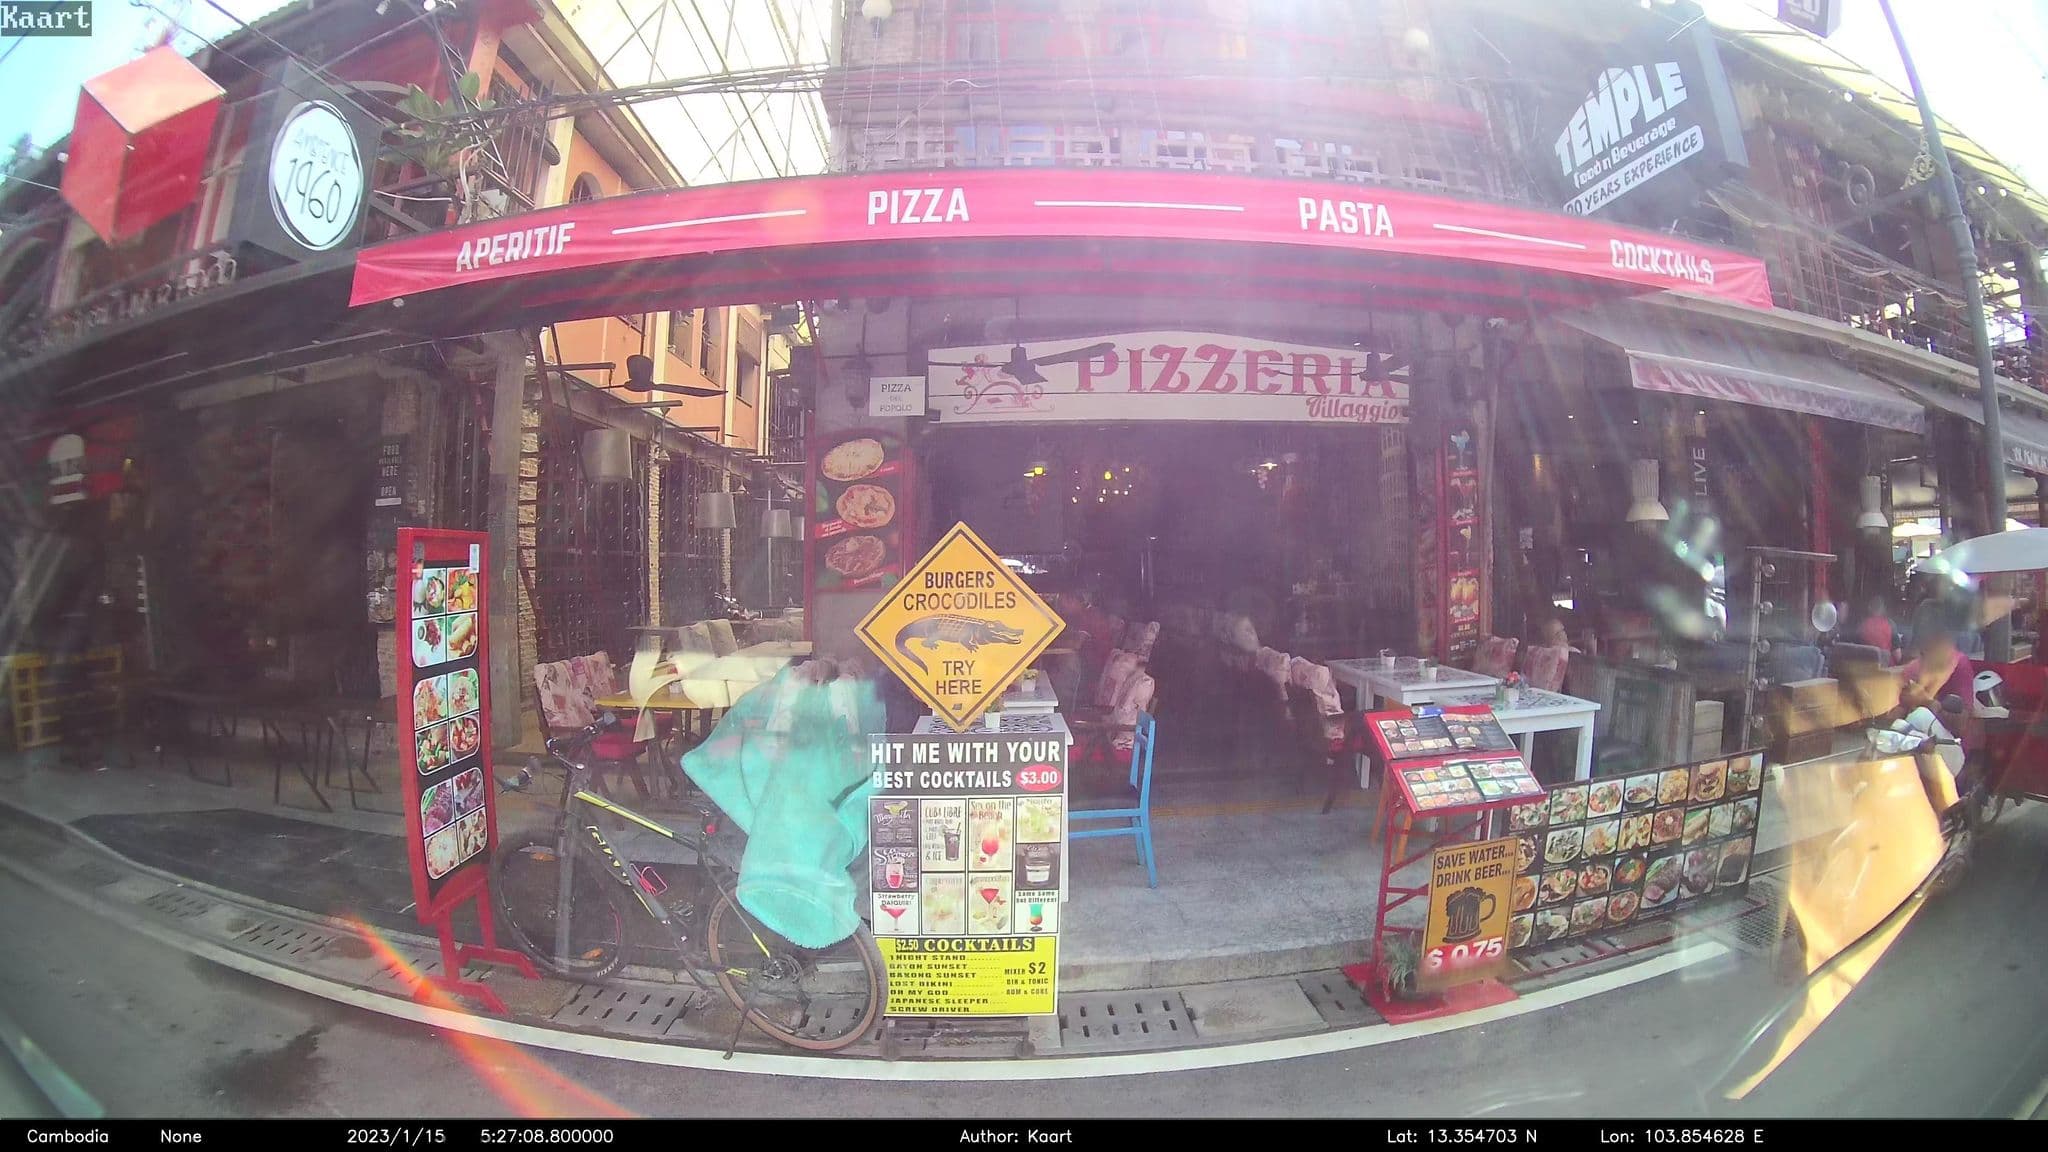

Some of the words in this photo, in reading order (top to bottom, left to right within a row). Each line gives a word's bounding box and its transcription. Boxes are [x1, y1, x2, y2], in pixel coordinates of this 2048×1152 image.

[1555, 62, 1688, 176] TEMPLE
[1611, 117, 1676, 164] Beverage
[1585, 178, 1621, 210] YEARS
[1624, 132, 1698, 186] EXPERIENCE
[284, 158, 342, 223] 1960
[867, 188, 970, 225] PIZZA
[1299, 197, 1394, 238] PASTA
[456, 222, 575, 272] APERITIF
[1610, 239, 1715, 286] COCKTAILS
[1075, 343, 1400, 399] PIZZERIA
[881, 384, 912, 392] PIZZA
[1306, 396, 1398, 423] Villaggio
[1693, 447, 1710, 496] LIVE
[925, 571, 995, 589] BURGERS
[903, 592, 1016, 611] CROCODILES
[942, 660, 975, 676] TRY
[935, 680, 982, 695] HERE
[871, 742, 904, 764] HIT
[912, 742, 940, 763] ME
[947, 742, 998, 763] WITH
[1007, 741, 1060, 763] YOUR
[872, 771, 914, 789] BEST
[920, 770, 1012, 789] COCKTAILS
[1020, 771, 1058, 785] $3.00
[1437, 852, 1465, 870] SAVE
[1469, 845, 1514, 864] WATER...
[1436, 868, 1472, 888] DRINK
[1474, 862, 1511, 881] BEER...
[895, 939, 919, 951] $2.50
[923, 938, 1033, 951] COCKTAILS
